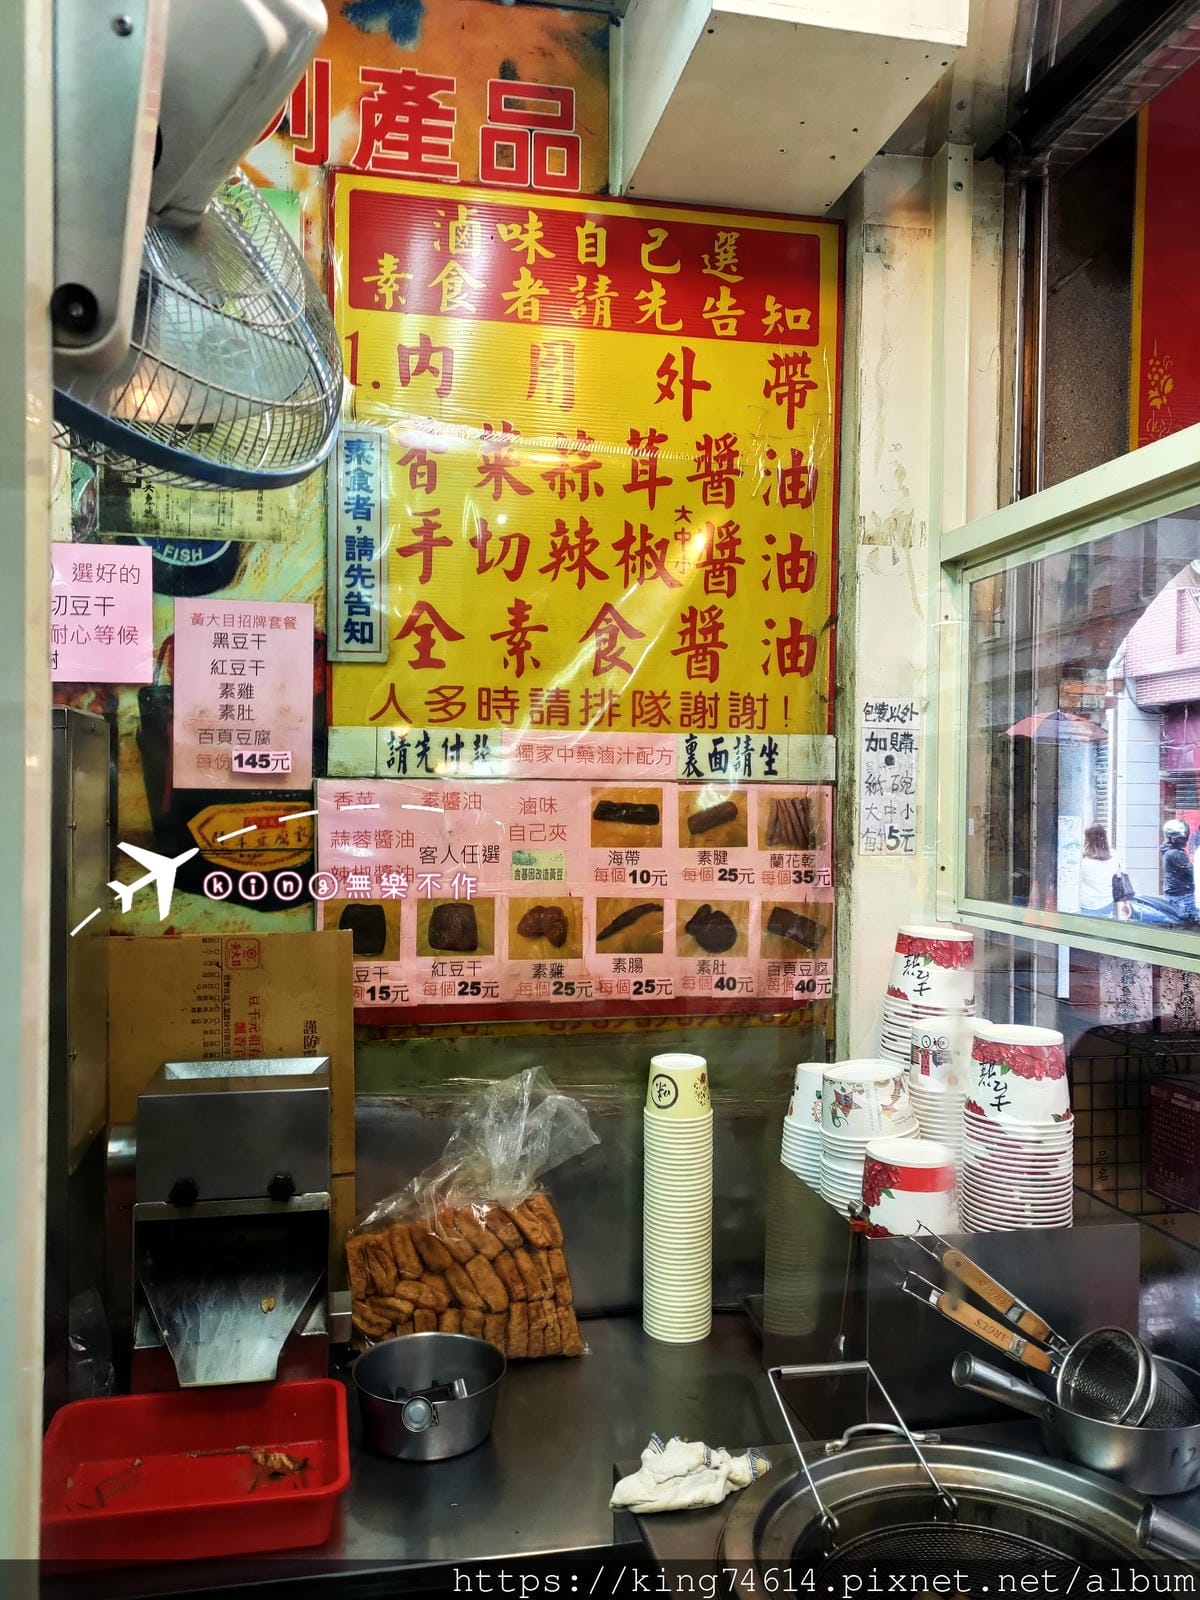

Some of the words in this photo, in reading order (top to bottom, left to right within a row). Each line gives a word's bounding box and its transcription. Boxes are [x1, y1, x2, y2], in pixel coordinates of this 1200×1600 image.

[433, 204, 744, 284] 滷味自己選
[363, 252, 812, 338] 素食者請先告知
[163, 544, 203, 561] FISH
[395, 507, 818, 600] 手切辣椒醬油
[72, 561, 141, 585] 選好的
[191, 612, 297, 630] 黃大目招牌套餐
[51, 624, 140, 647] 耐心等候
[212, 632, 268, 651] 黑豆干
[392, 598, 818, 686] 全素食醬油
[210, 658, 266, 677] 紅豆干
[218, 682, 255, 700] 素雞
[218, 704, 256, 721] 素肚
[197, 728, 272, 746] 百頁豆腐
[865, 731, 919, 754] 加購
[515, 744, 674, 765] 獨家中藥滷汁配方
[334, 791, 376, 811] 香菜
[518, 796, 558, 816] 滷味
[865, 802, 915, 823] 大中小
[509, 823, 568, 843] 自己夾
[419, 844, 500, 865] 客人任選
[607, 850, 641, 867] 海帶
[697, 850, 729, 866] 素腱
[770, 853, 816, 869] 蘭花乾
[431, 960, 482, 978] 紅豆干
[532, 962, 565, 979] 素雞
[612, 957, 644, 974] 素腸
[697, 960, 728, 976] 素肚
[974, 1318, 1010, 1342] ARGUS
